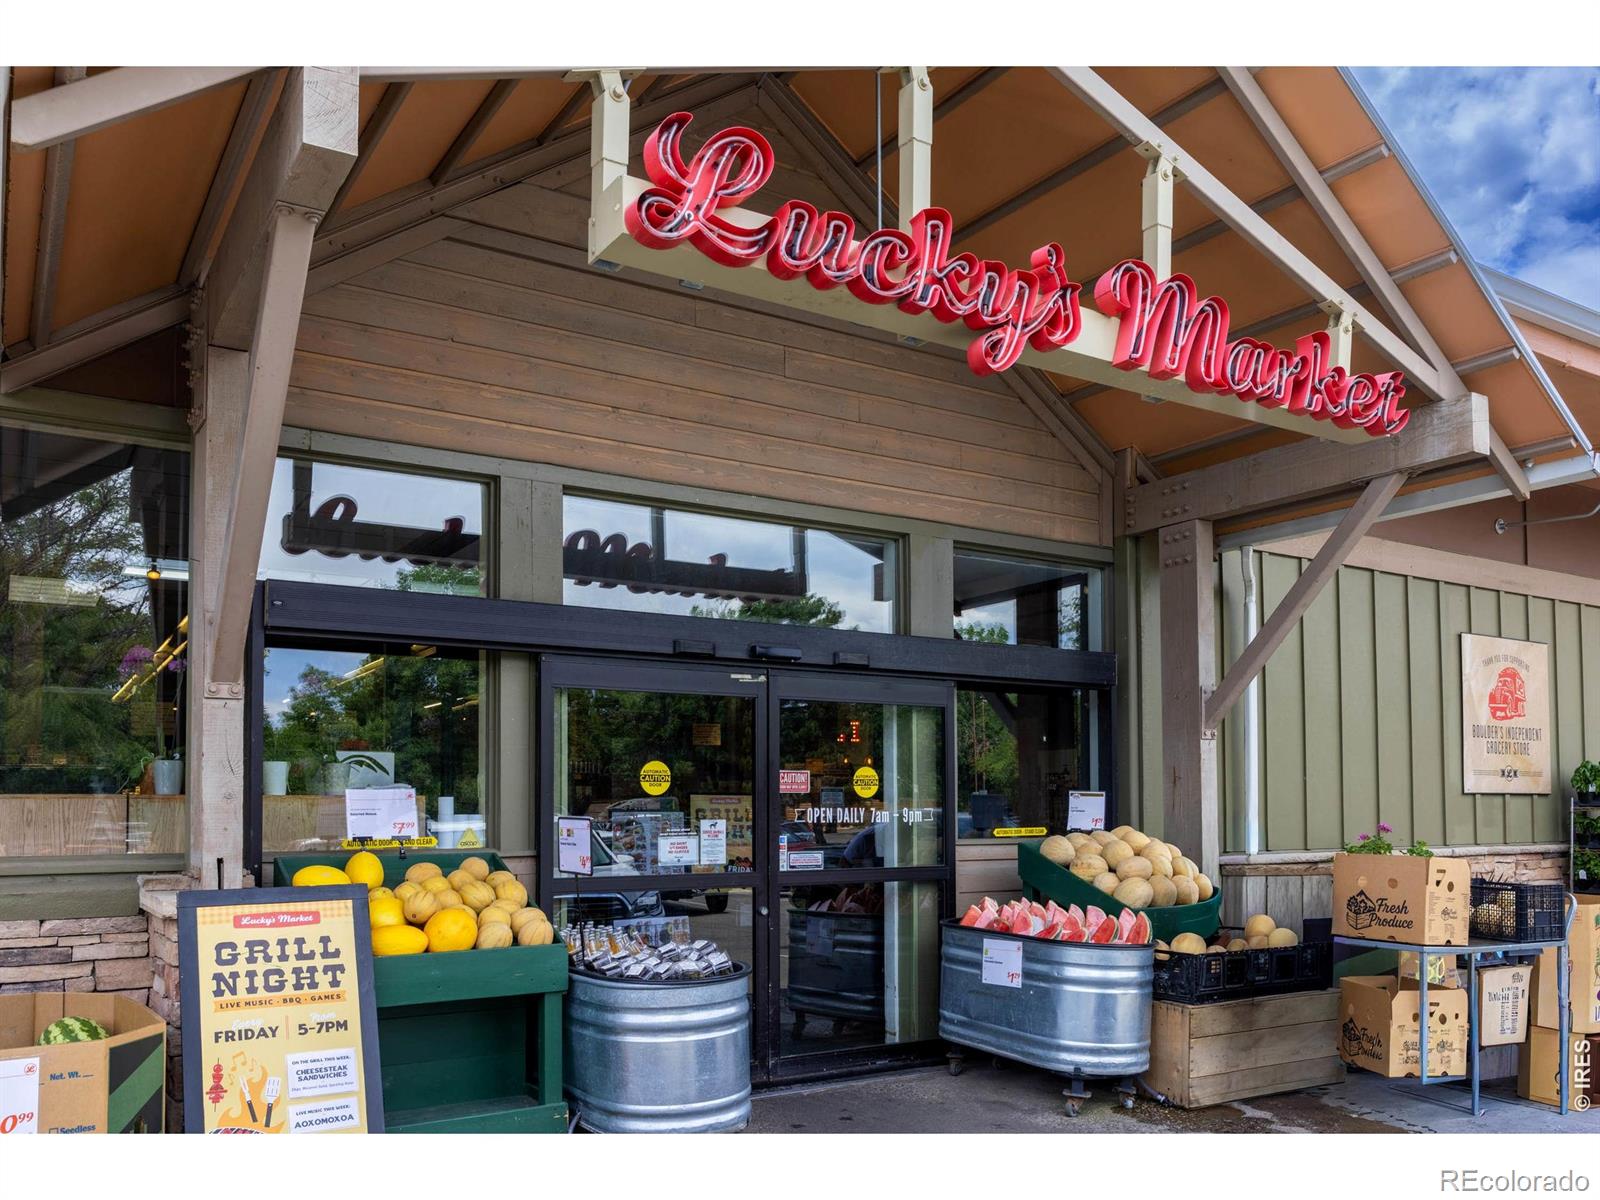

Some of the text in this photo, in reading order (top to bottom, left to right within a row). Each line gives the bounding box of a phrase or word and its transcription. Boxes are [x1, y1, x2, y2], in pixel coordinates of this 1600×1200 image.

[625, 111, 1411, 438] Lucky's Market
[1472, 724, 1542, 741] BOULDER'S INDEPENDENT
[1486, 740, 1530, 756] GROCERY STORE
[807, 807, 833, 823] OPEN
[837, 807, 865, 823] DAILY
[870, 808, 890, 823] 7am
[902, 807, 922, 826] 9pm
[347, 838, 377, 848] AUTOATIC
[378, 839, 394, 847] DOOR
[397, 838, 415, 846] SAND
[415, 837, 432, 846] CLEAR
[1376, 898, 1409, 914] Fresh
[241, 914, 314, 926] Lucky's Market
[1368, 913, 1414, 929] Produce
[214, 935, 342, 967] GRILL
[211, 963, 346, 998] NIGHT
[220, 993, 342, 1010] LIVE MUSIC BBQ GAMES
[214, 1025, 279, 1043] FRIDAY
[298, 1019, 348, 1036] 5-7PM
[49, 1071, 81, 1081] Net. Wt.
[296, 1064, 348, 1076] CHEESESTEAK
[297, 1071, 348, 1082] SANDWICHES
[60, 1124, 96, 1134] Seedless
[294, 1113, 355, 1129] AOXOMOXOA
